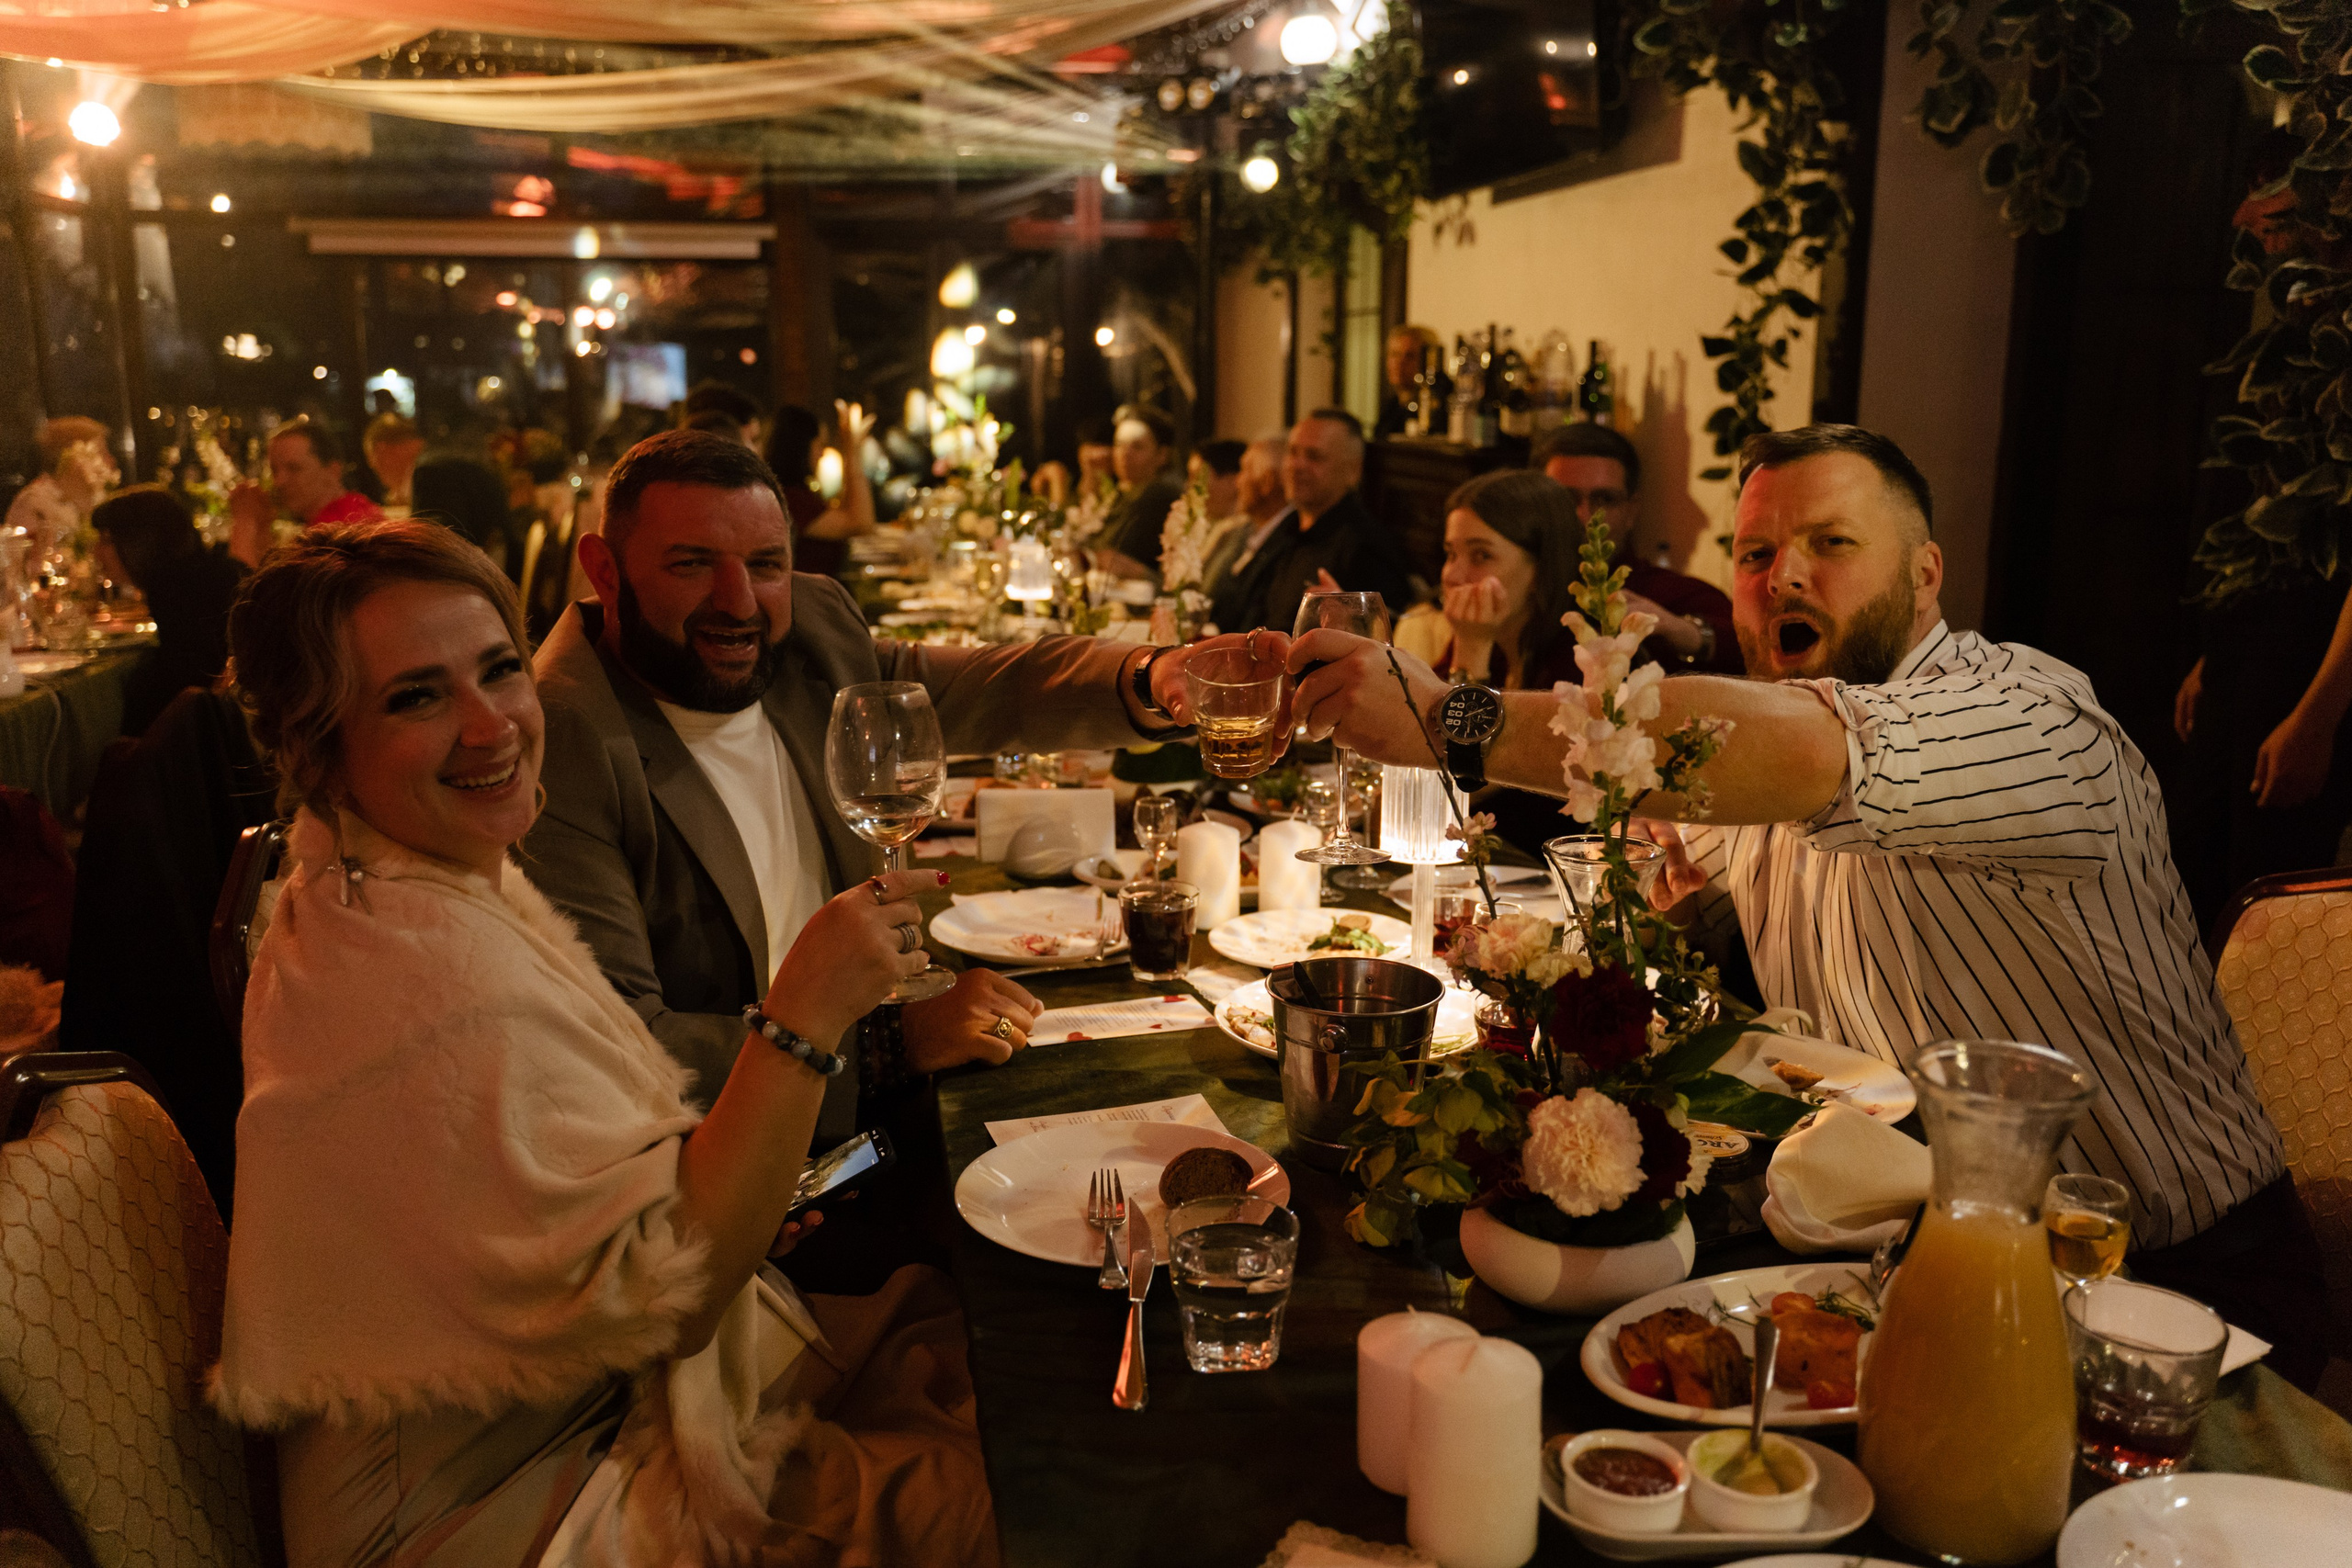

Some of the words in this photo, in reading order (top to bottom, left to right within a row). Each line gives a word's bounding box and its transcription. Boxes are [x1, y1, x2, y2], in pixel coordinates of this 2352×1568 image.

[1449, 701, 1465, 709] 04
[1447, 709, 1464, 717] 03
[1445, 717, 1462, 727] 02
